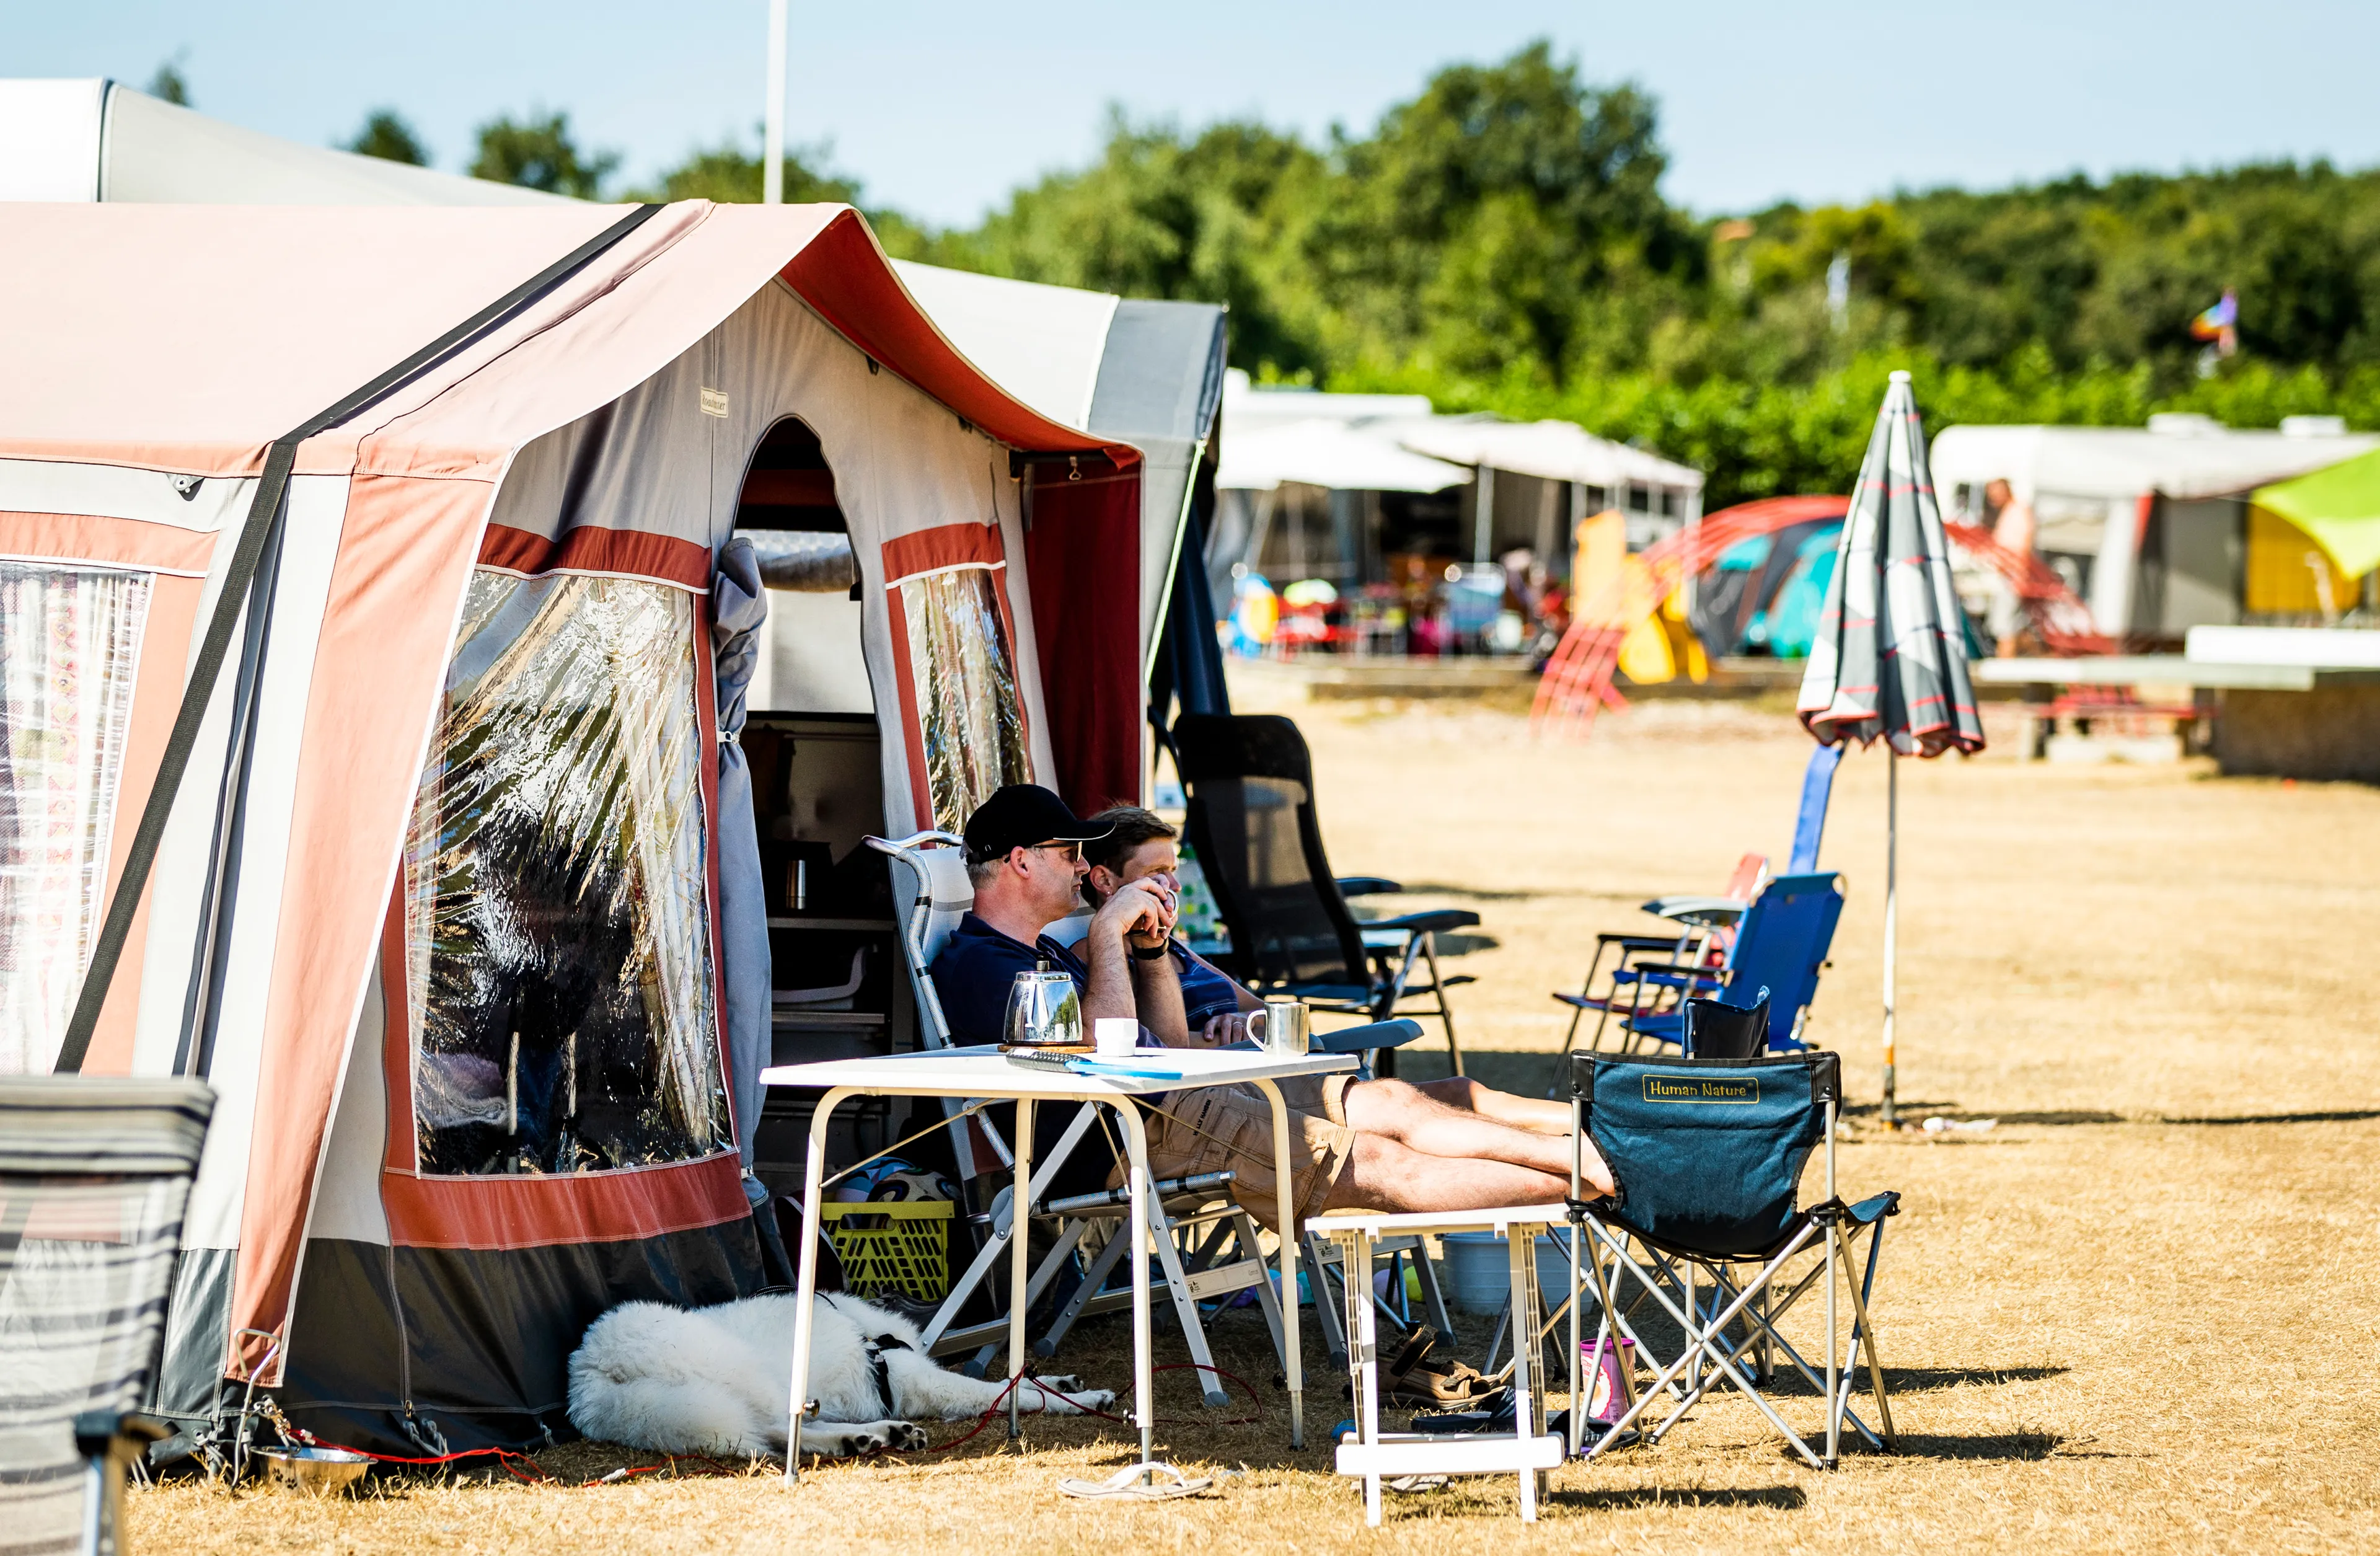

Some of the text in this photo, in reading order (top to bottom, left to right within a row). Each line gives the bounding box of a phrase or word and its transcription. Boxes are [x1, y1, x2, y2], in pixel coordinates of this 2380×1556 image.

[1651, 1081, 1747, 1097] Human Nature
[1192, 1118, 1203, 1136] HLLY
